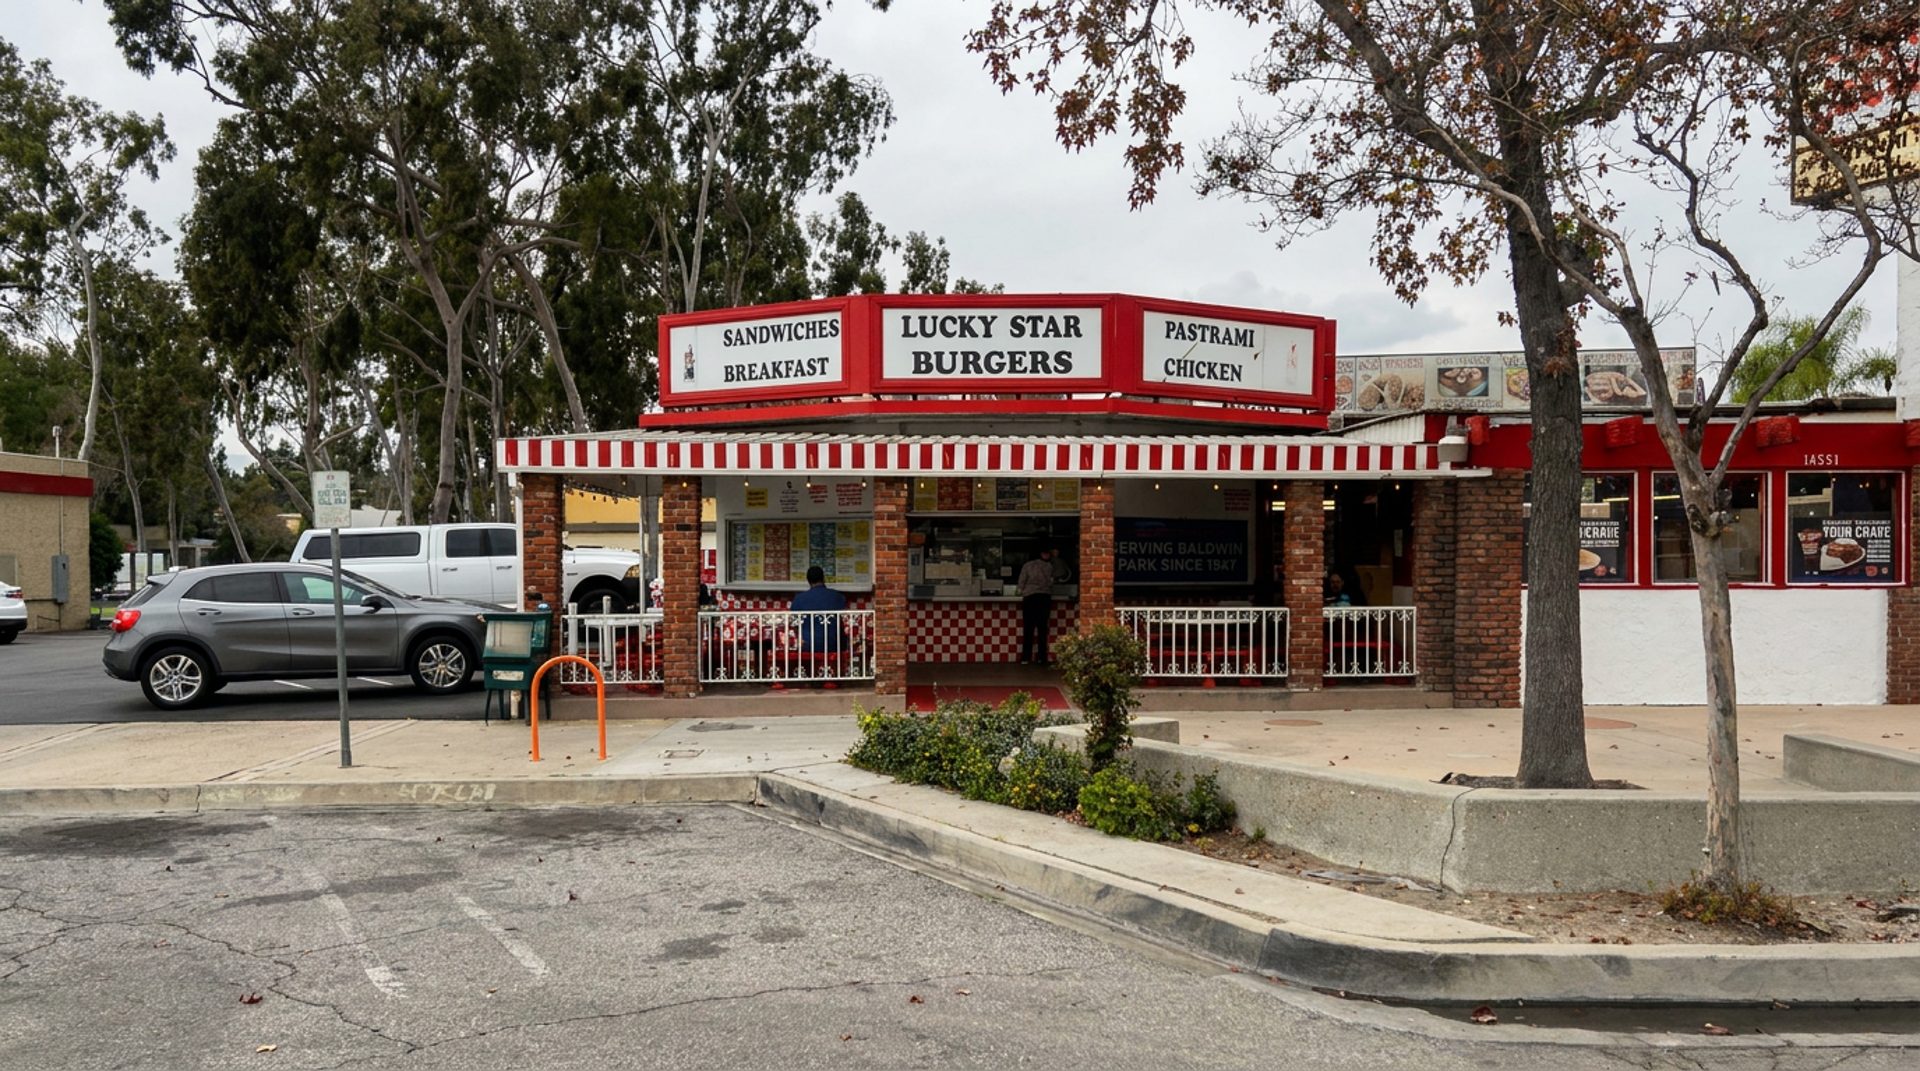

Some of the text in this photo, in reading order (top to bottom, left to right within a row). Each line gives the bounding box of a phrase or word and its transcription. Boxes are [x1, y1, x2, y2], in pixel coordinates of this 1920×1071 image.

[723, 319, 840, 347] SANDWICHES
[901, 315, 1083, 338] LUCKY STAR
[1165, 320, 1255, 348] PASTRAMI
[723, 357, 829, 383] BREAKFAST
[911, 350, 1073, 374] BURGERS
[1164, 358, 1243, 382] CHICKEN
[1822, 526, 1852, 538] YOUR
[1177, 542, 1243, 555] BALDWIN
[1117, 558, 1157, 571] PARK
[1160, 559, 1203, 571] SINCE
